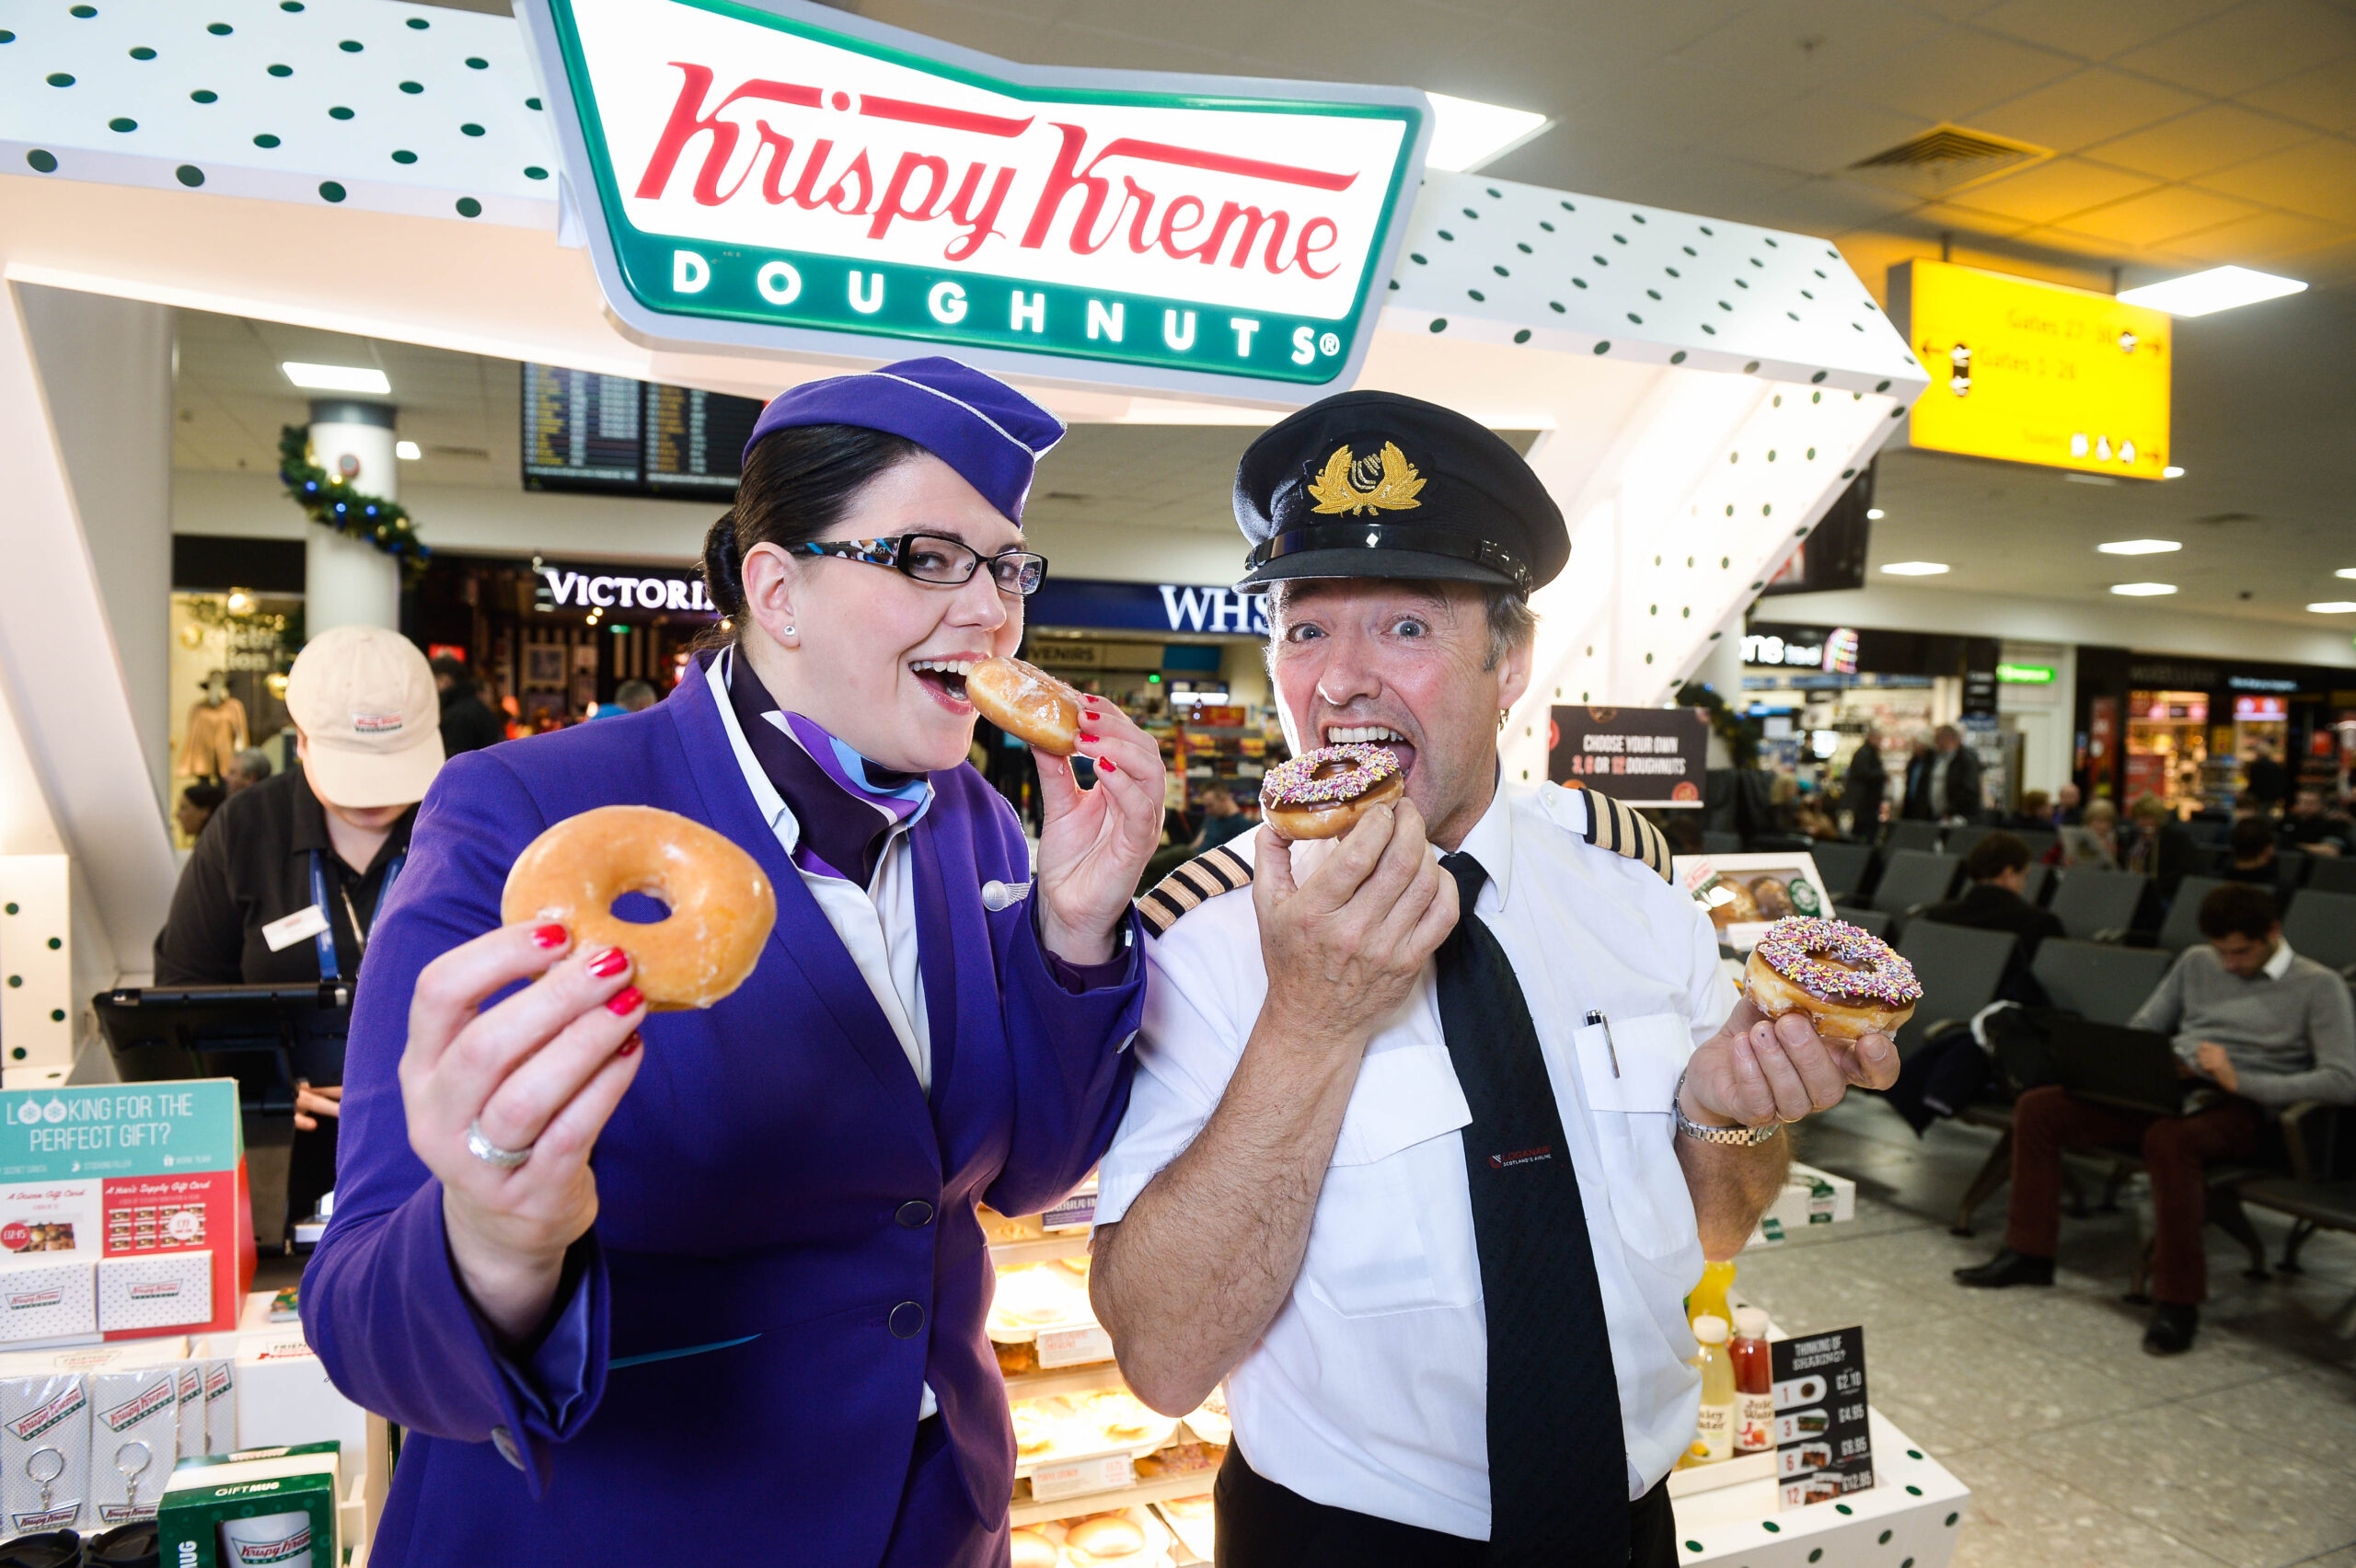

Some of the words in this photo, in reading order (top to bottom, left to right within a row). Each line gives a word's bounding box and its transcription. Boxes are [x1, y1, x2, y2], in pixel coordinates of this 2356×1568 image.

[633, 61, 1035, 261] Krispy
[1019, 121, 1359, 280] Kreme
[2007, 307, 2059, 336] Gates
[1978, 346, 2030, 374] Gates
[1583, 734, 1625, 753] CHOOSE
[1625, 735, 1653, 754] YOUR
[1654, 736, 1679, 754] OWN
[1594, 755, 1610, 774] OR
[1625, 756, 1686, 775] DOUGHNUTS
[116, 1095, 153, 1119] FOR
[157, 1093, 194, 1117] THE
[29, 1125, 114, 1152] PERFECT
[119, 1123, 171, 1148] GIFT?
[1502, 1146, 1552, 1161] LOGANAIR
[1503, 1158, 1533, 1167] SCOTLAND'S
[1534, 1153, 1552, 1161] AIRLINE
[139, 1182, 169, 1195] Supply
[170, 1182, 188, 1193] Gift
[189, 1180, 212, 1190] Card
[1795, 1337, 1831, 1357] THINKING
[1792, 1350, 1846, 1371] SHARING?
[1786, 1487, 1800, 1506] 12
[241, 1542, 282, 1558] Krispy
[282, 1530, 311, 1553] Krem
